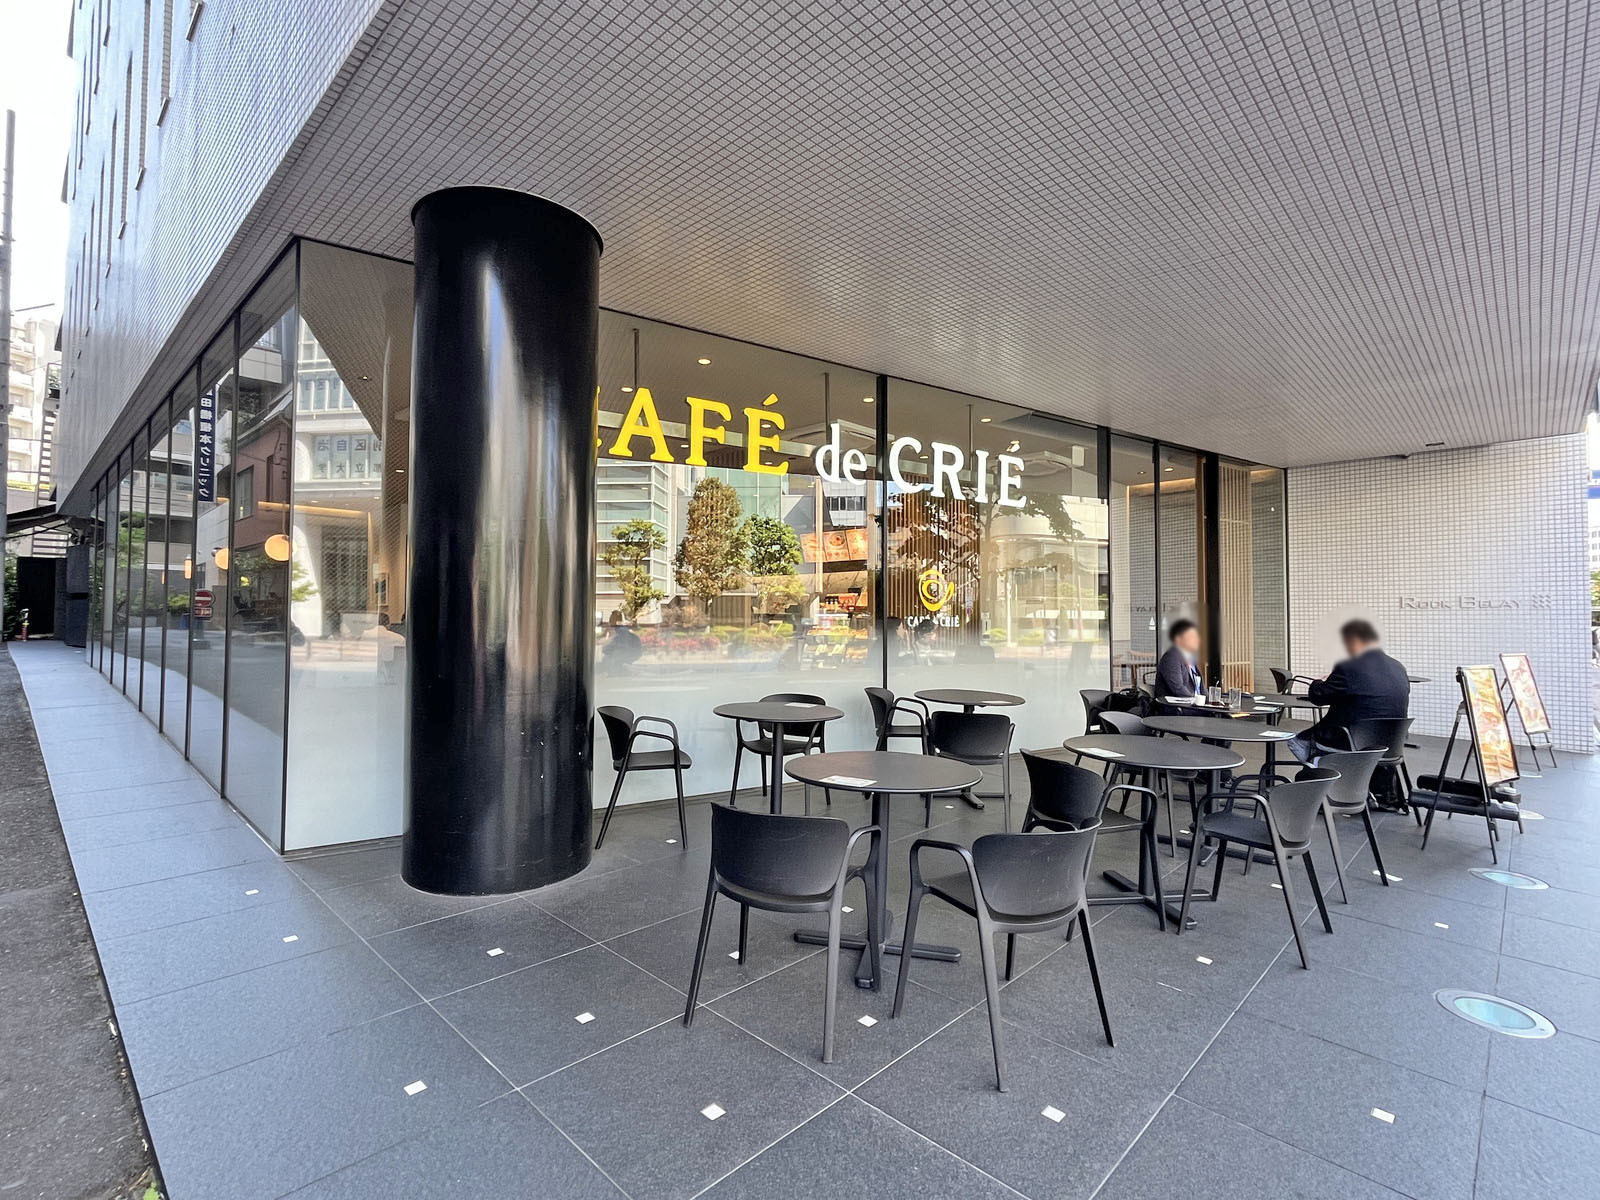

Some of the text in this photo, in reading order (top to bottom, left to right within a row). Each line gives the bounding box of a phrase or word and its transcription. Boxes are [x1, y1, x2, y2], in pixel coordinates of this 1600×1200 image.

[597, 387, 1028, 508] AFÉ de CRIÉ
